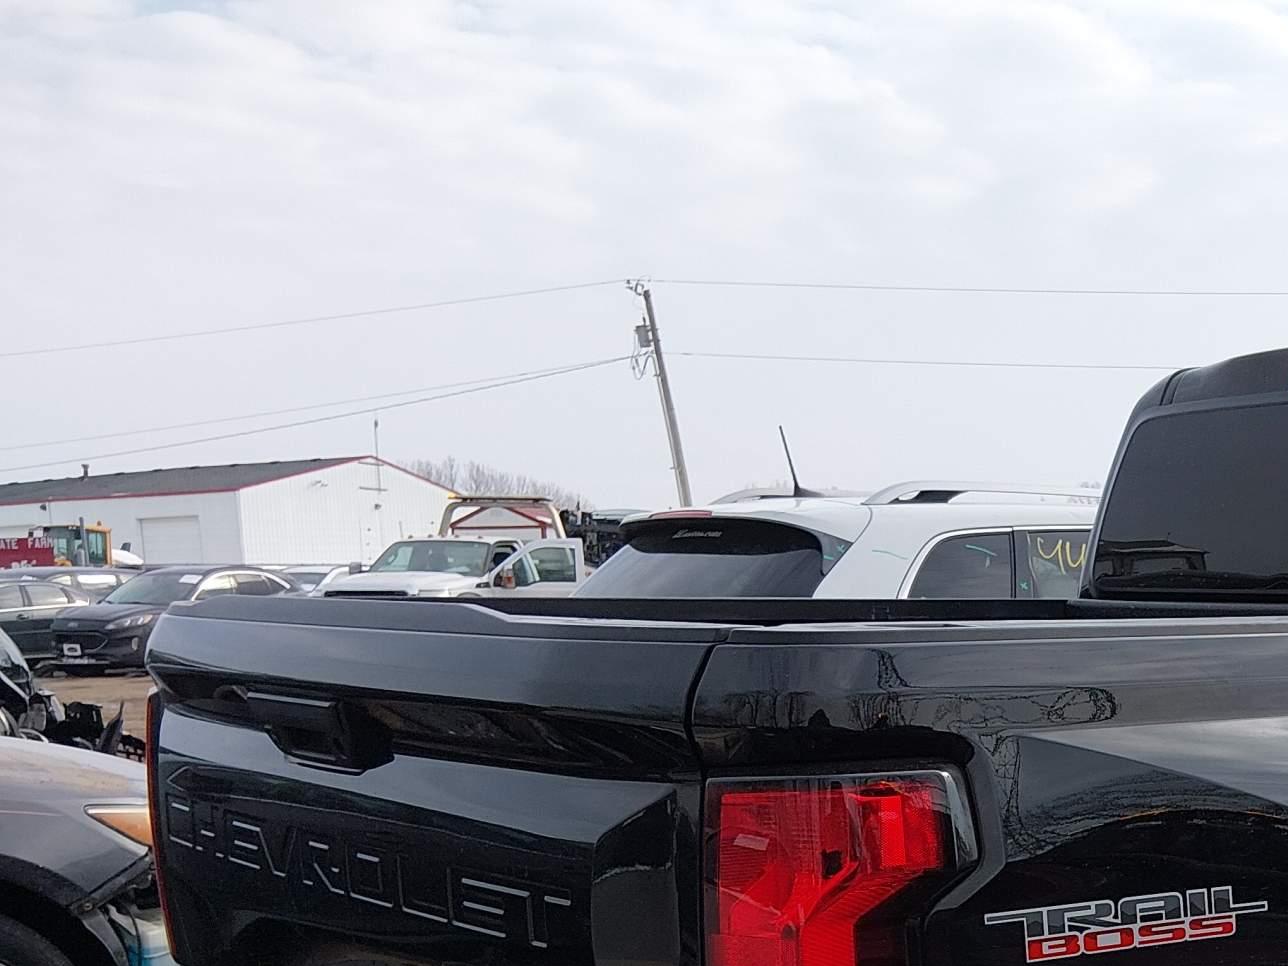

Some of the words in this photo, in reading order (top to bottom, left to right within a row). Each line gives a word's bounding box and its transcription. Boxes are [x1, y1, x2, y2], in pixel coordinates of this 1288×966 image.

[166, 792, 571, 949] CHEVROLET
[983, 885, 1269, 938] TRAIL
[1025, 913, 1237, 963] BOSS
